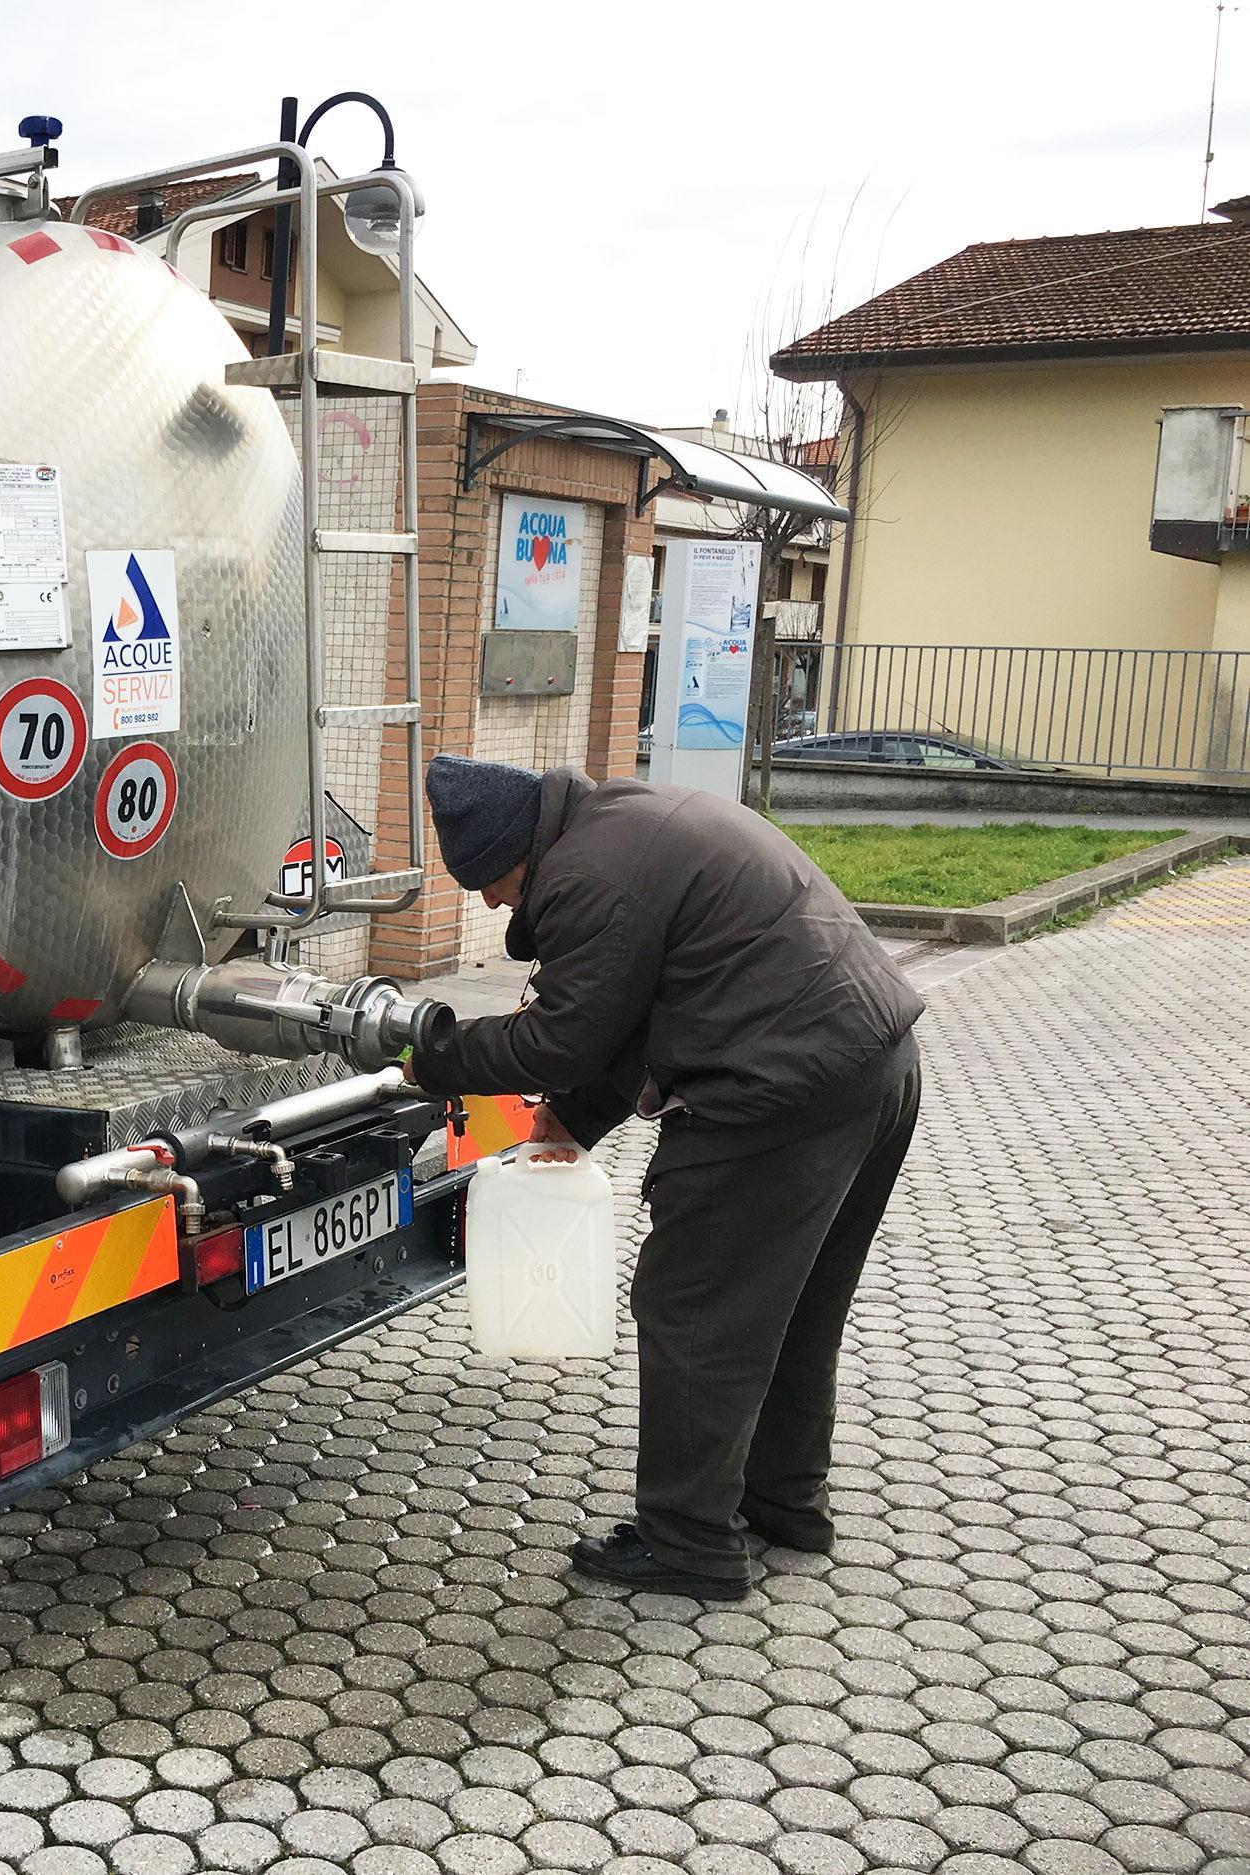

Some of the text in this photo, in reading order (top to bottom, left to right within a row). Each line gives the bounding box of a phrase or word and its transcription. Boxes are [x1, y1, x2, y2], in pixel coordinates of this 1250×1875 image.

[519, 511, 566, 538] ACQUA
[515, 538, 567, 565] BUNA
[103, 642, 172, 669] ACQUE
[103, 674, 173, 704] SERVIZI
[120, 712, 159, 725] 800 982 982
[19, 712, 65, 760] 70
[117, 776, 158, 823] 80
[267, 1178, 395, 1280] EL 866PT
